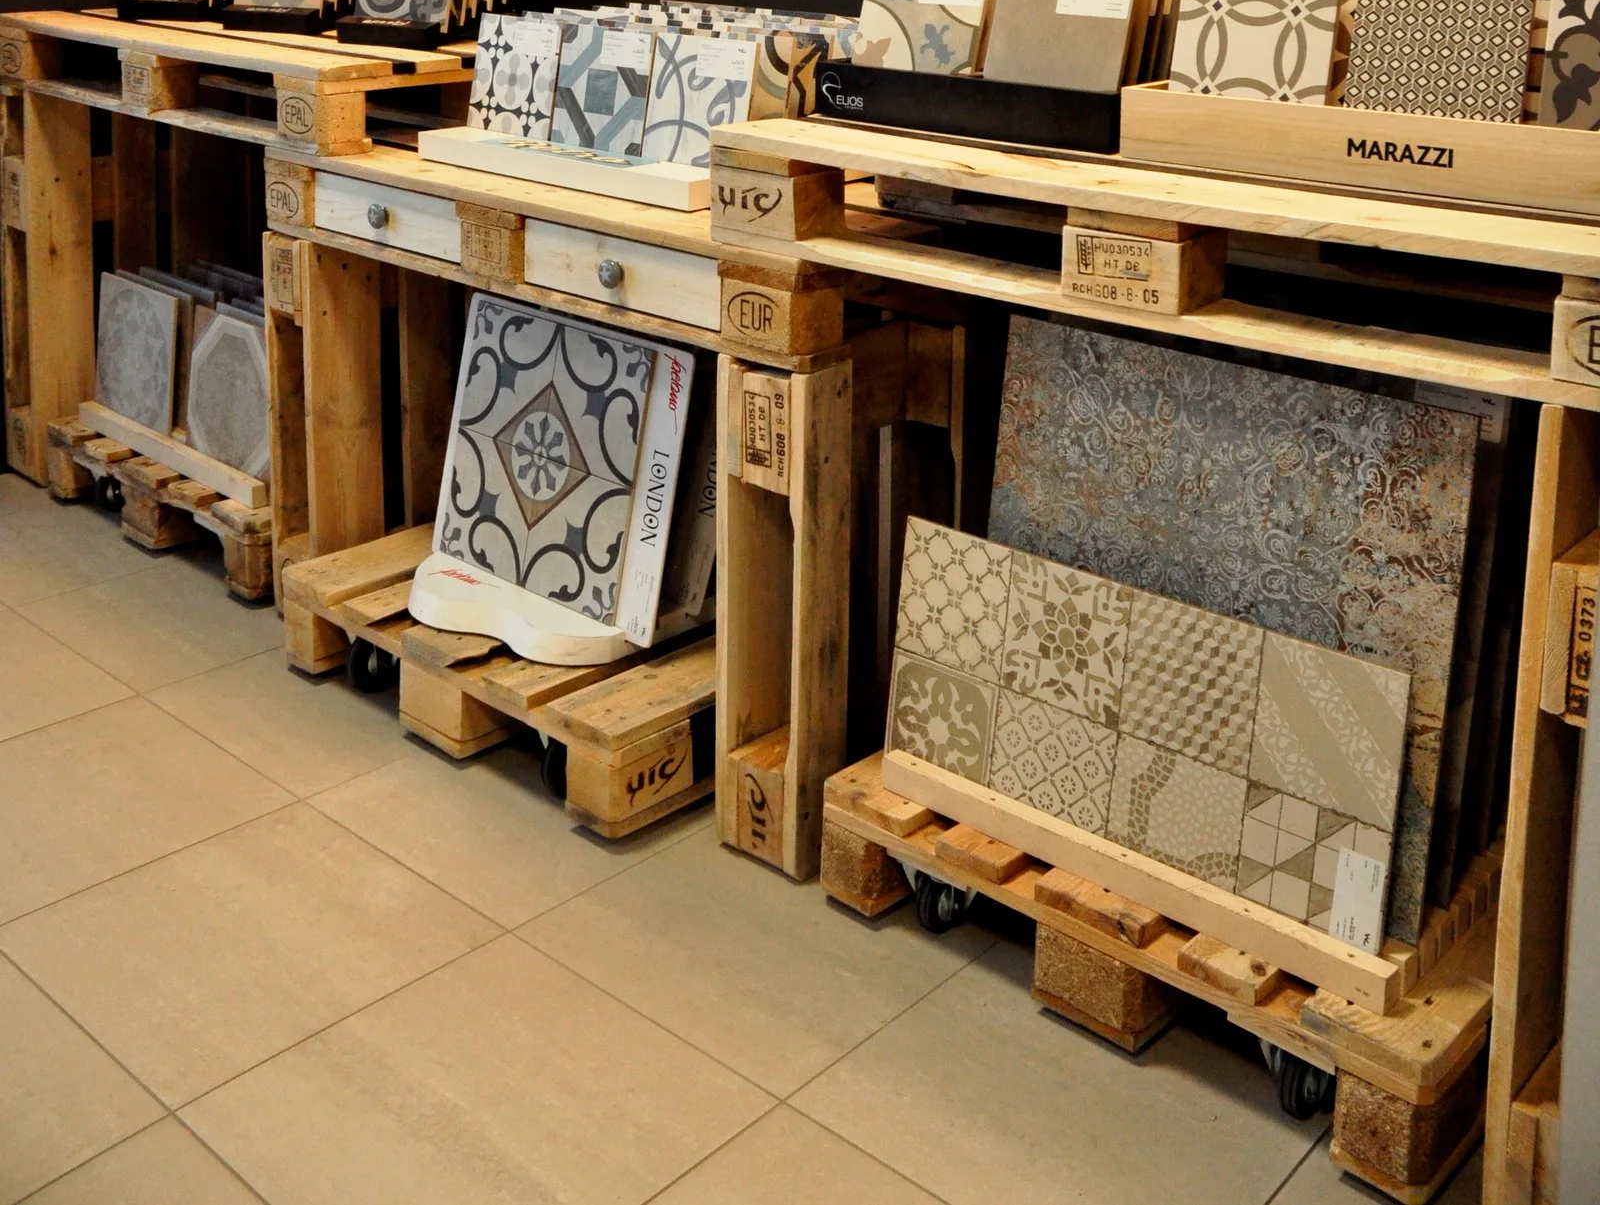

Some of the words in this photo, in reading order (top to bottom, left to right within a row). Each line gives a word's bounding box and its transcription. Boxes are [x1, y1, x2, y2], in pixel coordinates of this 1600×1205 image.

[836, 94, 863, 107] ELIOS
[284, 103, 310, 128] EPAL
[1346, 137, 1455, 169] MARAZZI
[269, 187, 295, 213] EPAL
[739, 298, 774, 334] EUR
[639, 449, 671, 547] LONDON
